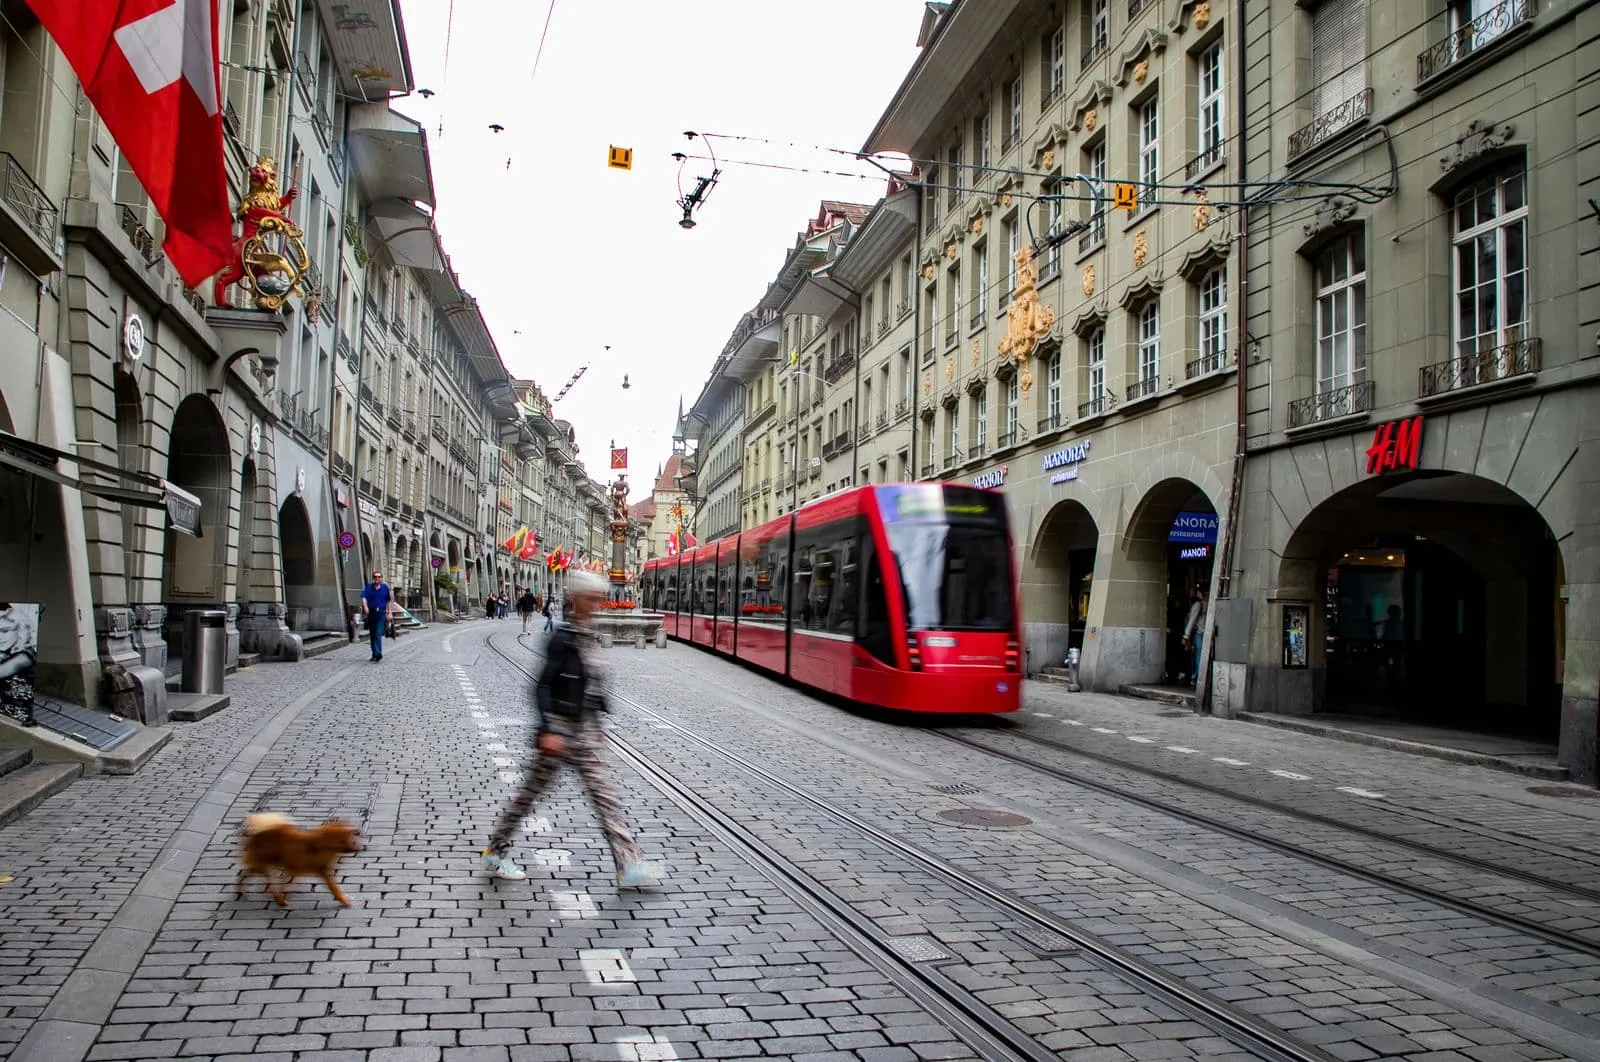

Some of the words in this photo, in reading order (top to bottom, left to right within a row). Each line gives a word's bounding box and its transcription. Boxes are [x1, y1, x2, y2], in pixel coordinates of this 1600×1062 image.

[1365, 415, 1425, 475] H&M
[1042, 444, 1087, 471] MANORA
[973, 470, 1004, 489] MANOR
[1174, 517, 1217, 529] ANORA
[1181, 547, 1207, 559] MANOR
